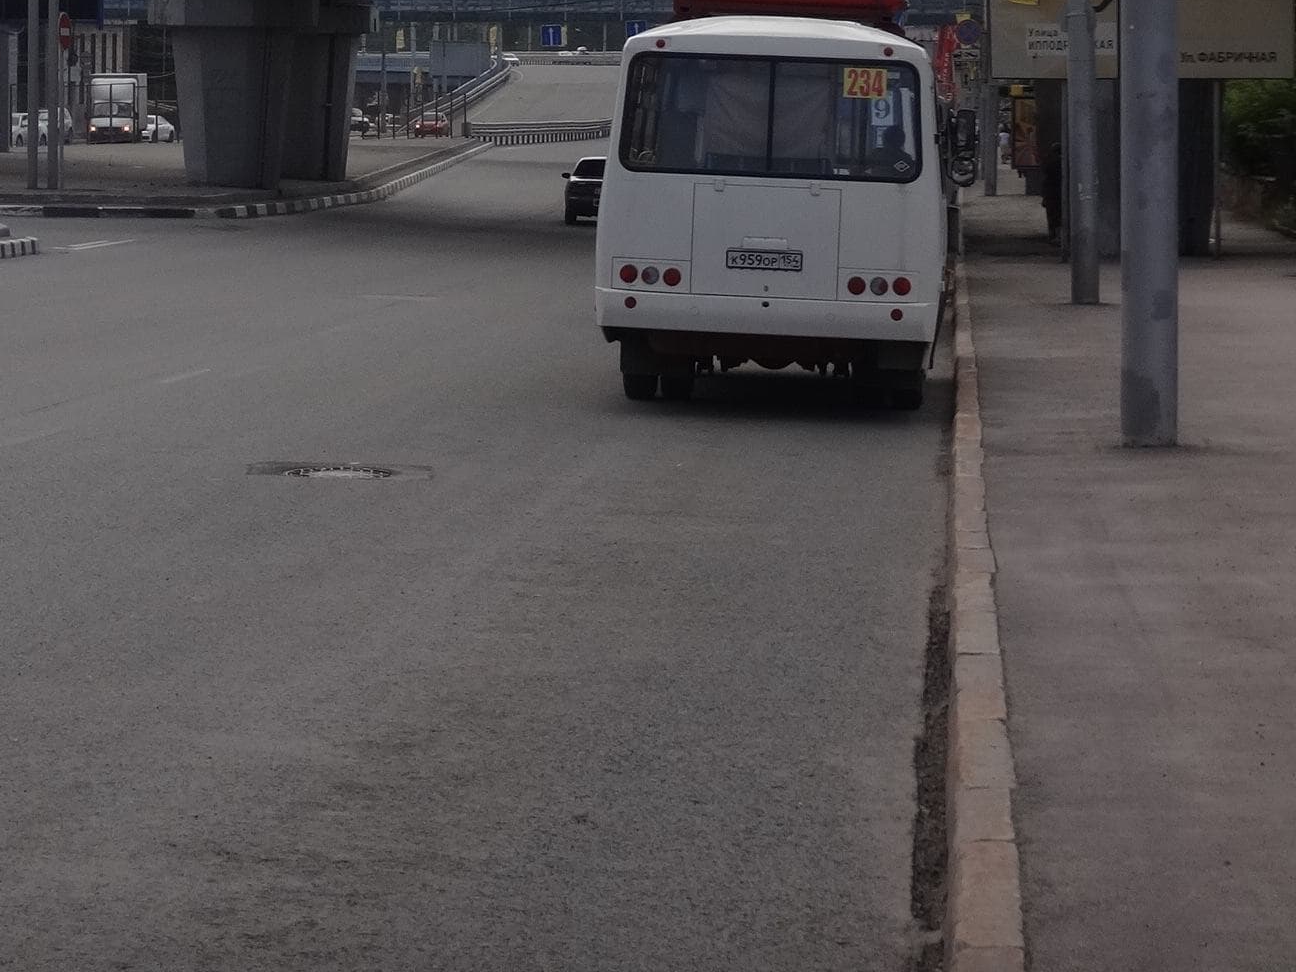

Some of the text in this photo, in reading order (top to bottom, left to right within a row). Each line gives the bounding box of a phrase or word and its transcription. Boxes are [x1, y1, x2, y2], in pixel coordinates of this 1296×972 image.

[1028, 28, 1058, 37] Улица
[1197, 51, 1277, 63] ФАБРИЧНАЯ
[847, 68, 884, 97] 234
[731, 253, 778, 267] К959ОР
